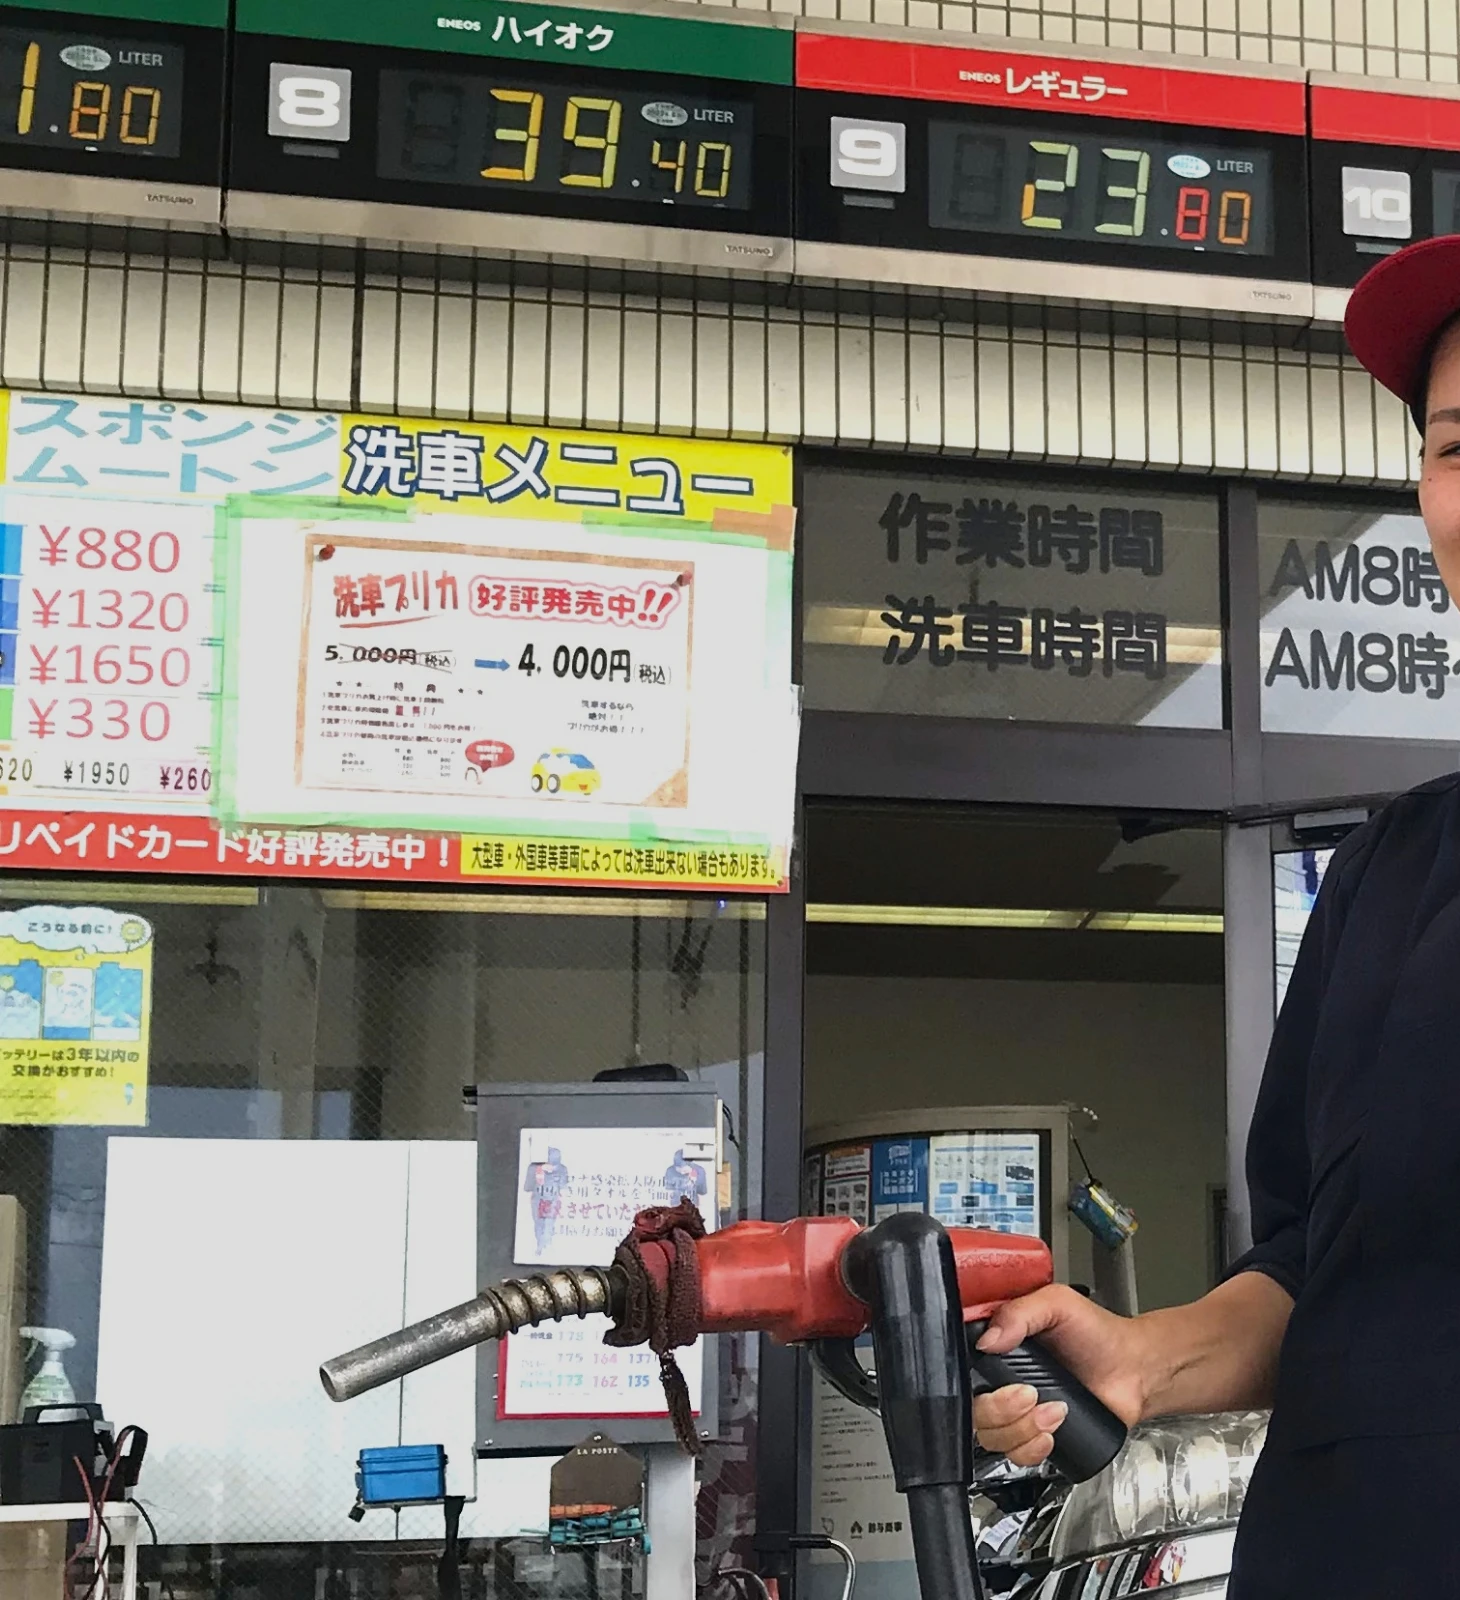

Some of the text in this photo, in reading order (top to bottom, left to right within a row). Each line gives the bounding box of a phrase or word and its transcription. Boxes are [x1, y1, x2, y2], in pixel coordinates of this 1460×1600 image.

[437, 15, 616, 52] ENEOS ハイオク
[119, 51, 163, 66] LITER
[279, 78, 341, 126] 8
[959, 67, 1127, 102] ENEOS レギュラー
[694, 109, 734, 124] LITER
[838, 130, 897, 177] 9
[1216, 159, 1254, 174] LITER
[146, 193, 195, 205] TATSUNO
[1343, 186, 1411, 223] 10
[726, 244, 772, 257] TATSUNO
[13, 396, 338, 454] スポンジ
[13, 446, 335, 496] ムートン
[343, 424, 754, 516] 洗車メニュー
[39, 524, 181, 573] ¥880
[879, 492, 1163, 577] 作業時間
[32, 587, 190, 632] ¥1320
[334, 570, 459, 618] 洗車プリカ
[880, 594, 1168, 681] 洗車時間
[29, 644, 191, 687] ¥1650
[28, 697, 171, 742] ¥330
[64, 759, 130, 786] ¥1950
[0, 1048, 140, 1063] ッテリーは3年以内の
[628, 1374, 650, 1388] 135
[577, 1447, 618, 1455] LA POSTE
